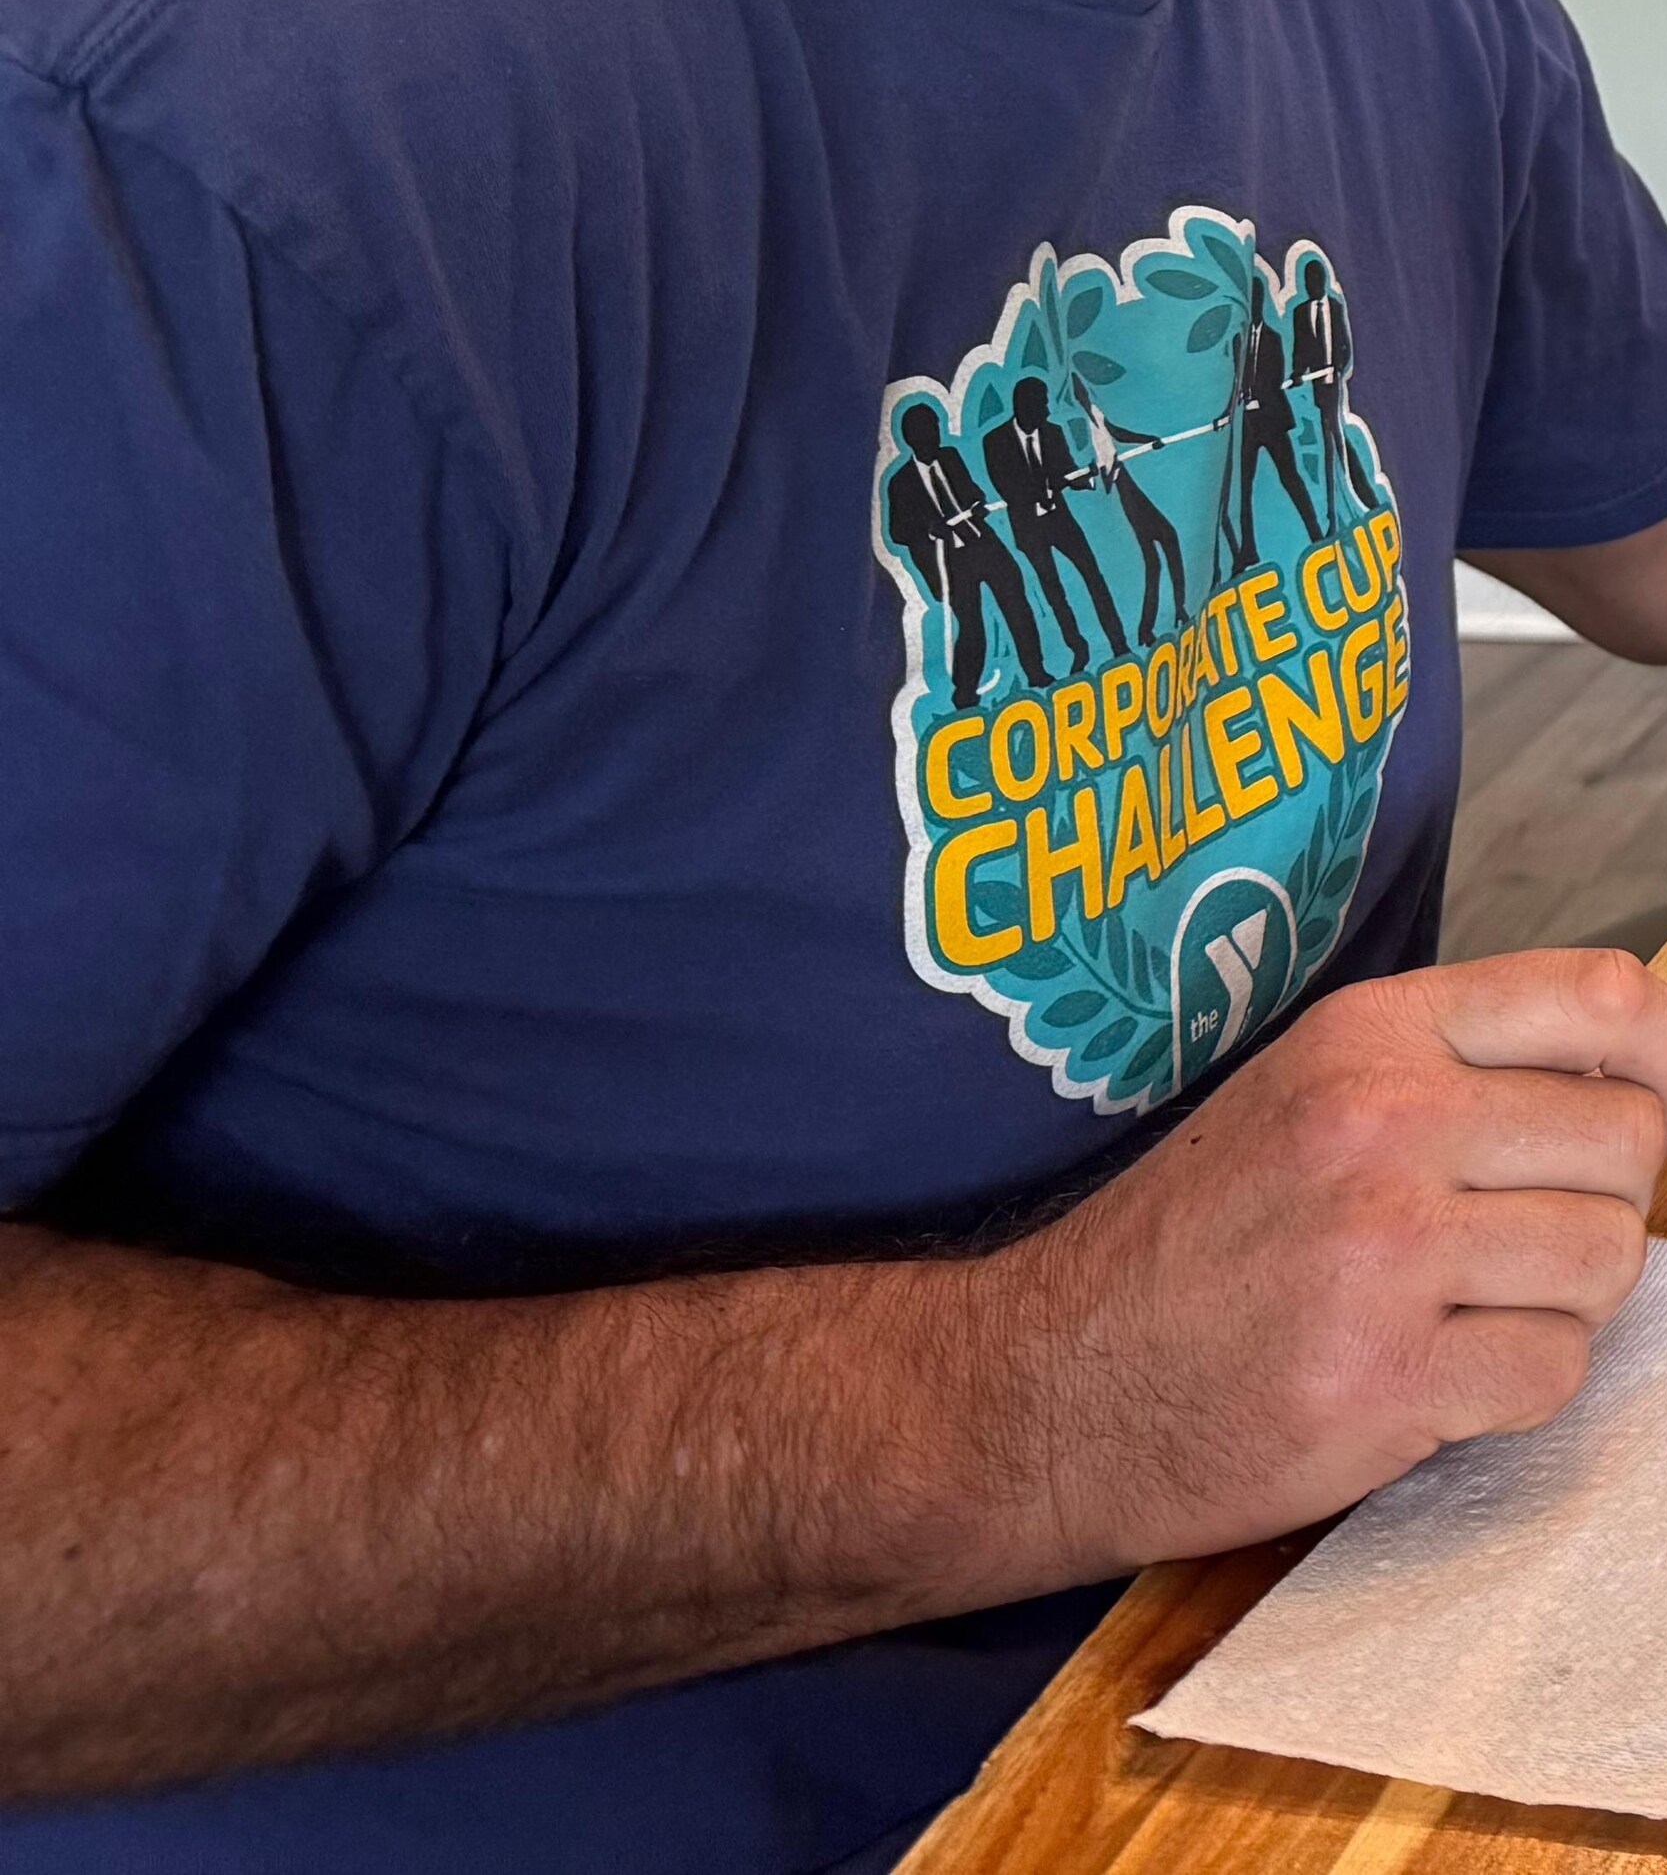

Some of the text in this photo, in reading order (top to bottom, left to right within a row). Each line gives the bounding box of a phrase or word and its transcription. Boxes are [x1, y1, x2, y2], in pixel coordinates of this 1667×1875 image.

[925, 510, 1400, 820] CORPORATE CUP
[934, 593, 1409, 969] CHALLENGE
[1190, 1008, 1220, 1043] the
